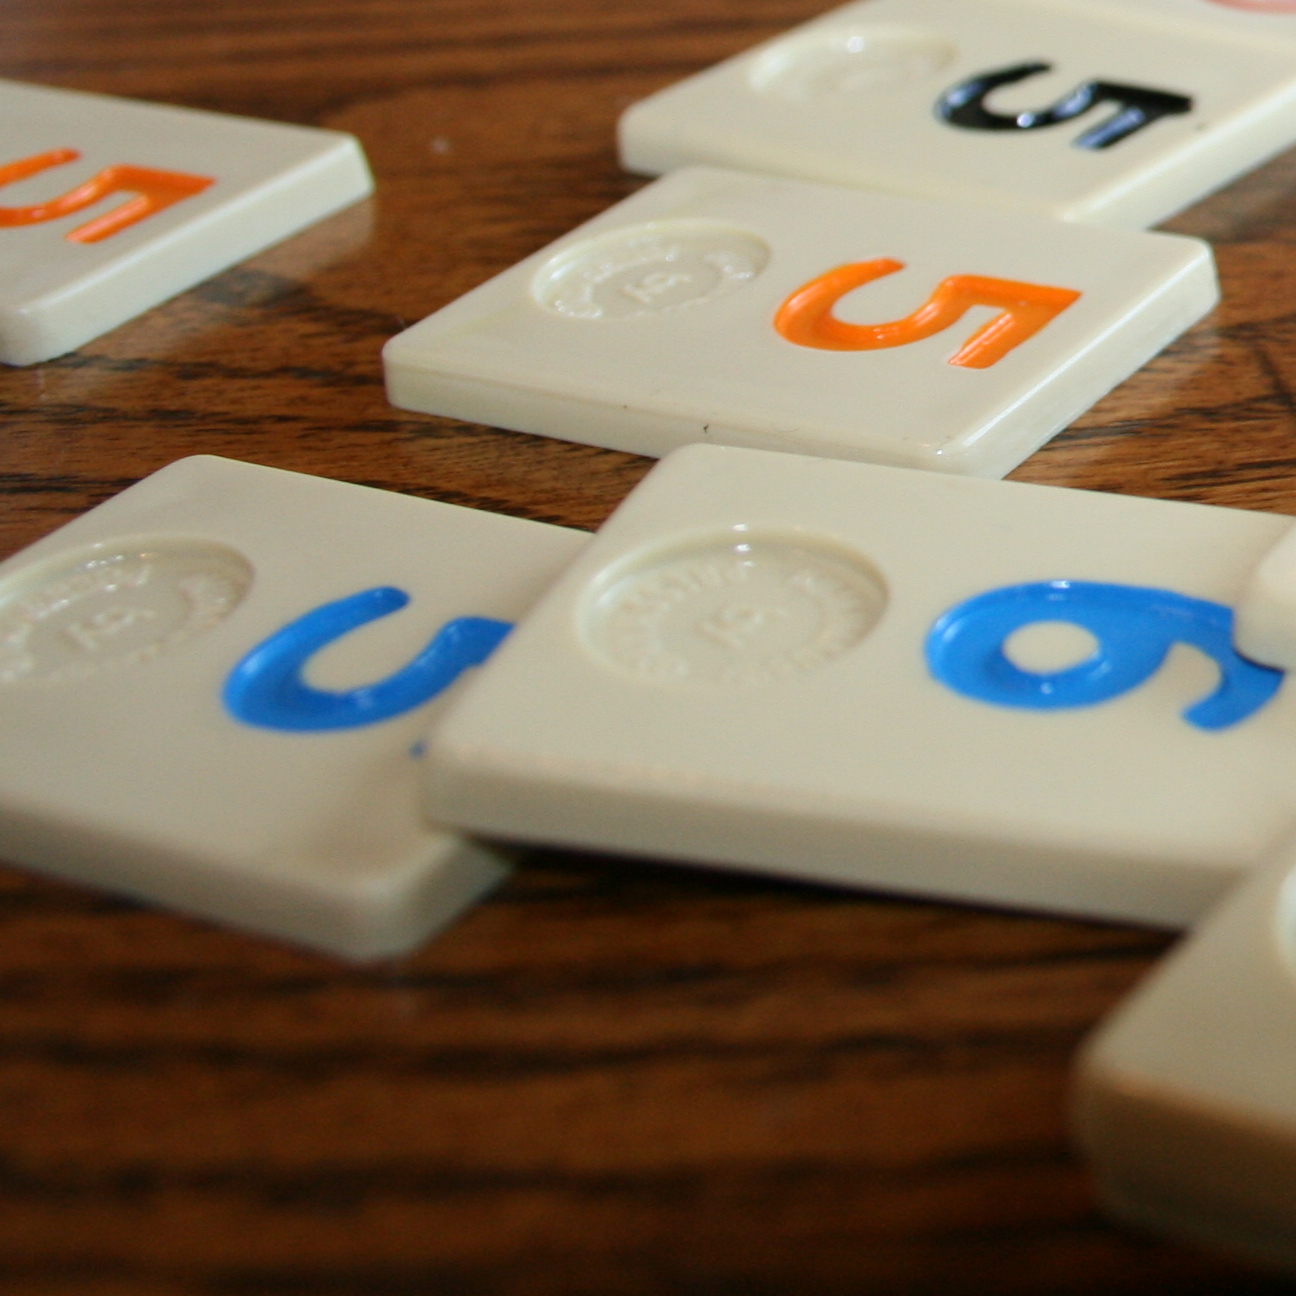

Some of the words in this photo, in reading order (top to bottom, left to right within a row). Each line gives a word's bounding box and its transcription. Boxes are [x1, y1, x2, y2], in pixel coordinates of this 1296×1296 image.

[934, 61, 1194, 150] 5
[0, 147, 217, 244] 5
[771, 258, 1083, 370] 5
[925, 580, 1285, 732] 6
